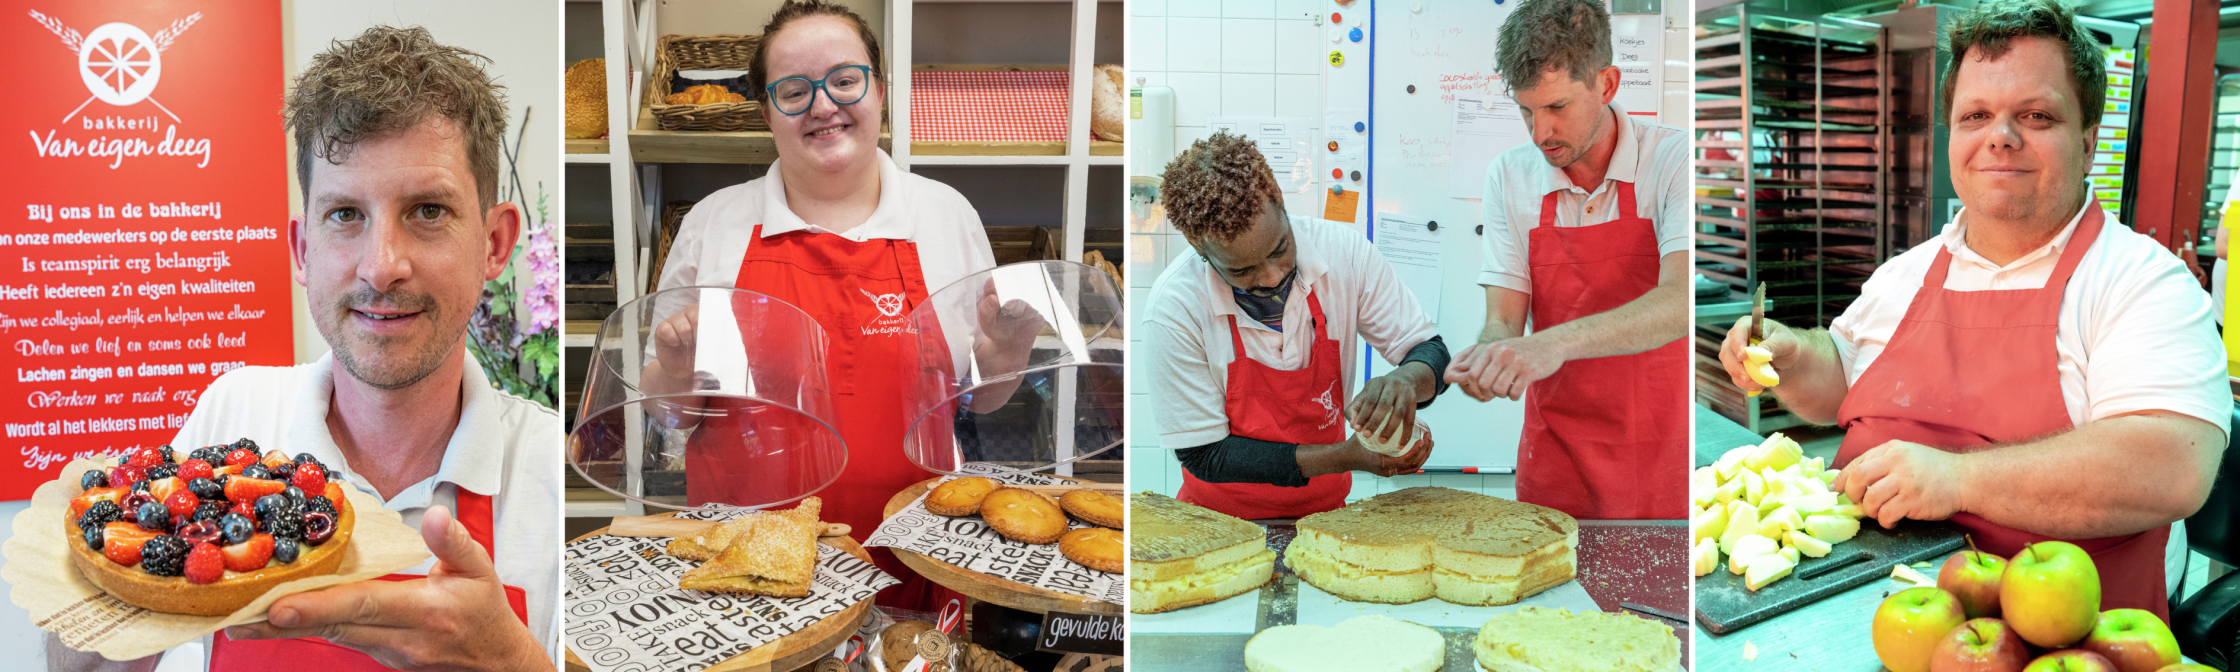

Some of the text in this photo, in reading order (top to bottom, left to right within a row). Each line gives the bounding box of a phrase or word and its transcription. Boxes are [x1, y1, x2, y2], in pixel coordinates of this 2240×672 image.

[1619, 36, 1646, 47] Koekjes
[83, 115, 159, 132] bakkerij
[29, 124, 212, 169] Van eigen deeg
[27, 201, 222, 223] Bij ons in de bakkerij
[15, 232, 50, 245] onze
[53, 228, 147, 245] medewerkers
[150, 231, 168, 245] op
[170, 227, 188, 242] de
[190, 227, 234, 241] eerste
[236, 225, 278, 243] plaats
[21, 250, 231, 276] Is teamspirit erg belangrijk
[0, 279, 256, 300] Heeft iedereen z'n eigen kwaliteiten
[19, 316, 39, 328] we
[41, 308, 104, 332] collegiaal,
[107, 307, 145, 329] eerlijk
[147, 312, 163, 323] en
[164, 305, 205, 327] helpen
[206, 309, 225, 321] we
[227, 303, 266, 320] elkaar
[860, 325, 880, 336] Van
[14, 331, 247, 357] Delen we lief en soms ook leed
[17, 366, 66, 383] Lachen
[69, 364, 113, 383] zingen
[117, 364, 134, 378] en
[137, 361, 184, 377] dansen
[187, 362, 206, 375] we
[27, 386, 197, 409] Werken we vaak erg
[5, 421, 46, 438] Wordt
[48, 418, 61, 435] al
[63, 417, 87, 434] het
[88, 415, 137, 433] lekkers
[138, 414, 166, 430] met
[20, 445, 68, 471] Zijn
[72, 449, 95, 461] we
[943, 533, 997, 554] snack
[927, 546, 983, 571] eat
[1011, 550, 1056, 587] SNACK
[575, 566, 651, 598] TAKE
[652, 607, 712, 636] snack
[1045, 614, 1110, 648] gevulde
[626, 627, 686, 669] TAKE
[673, 620, 739, 657] eat
